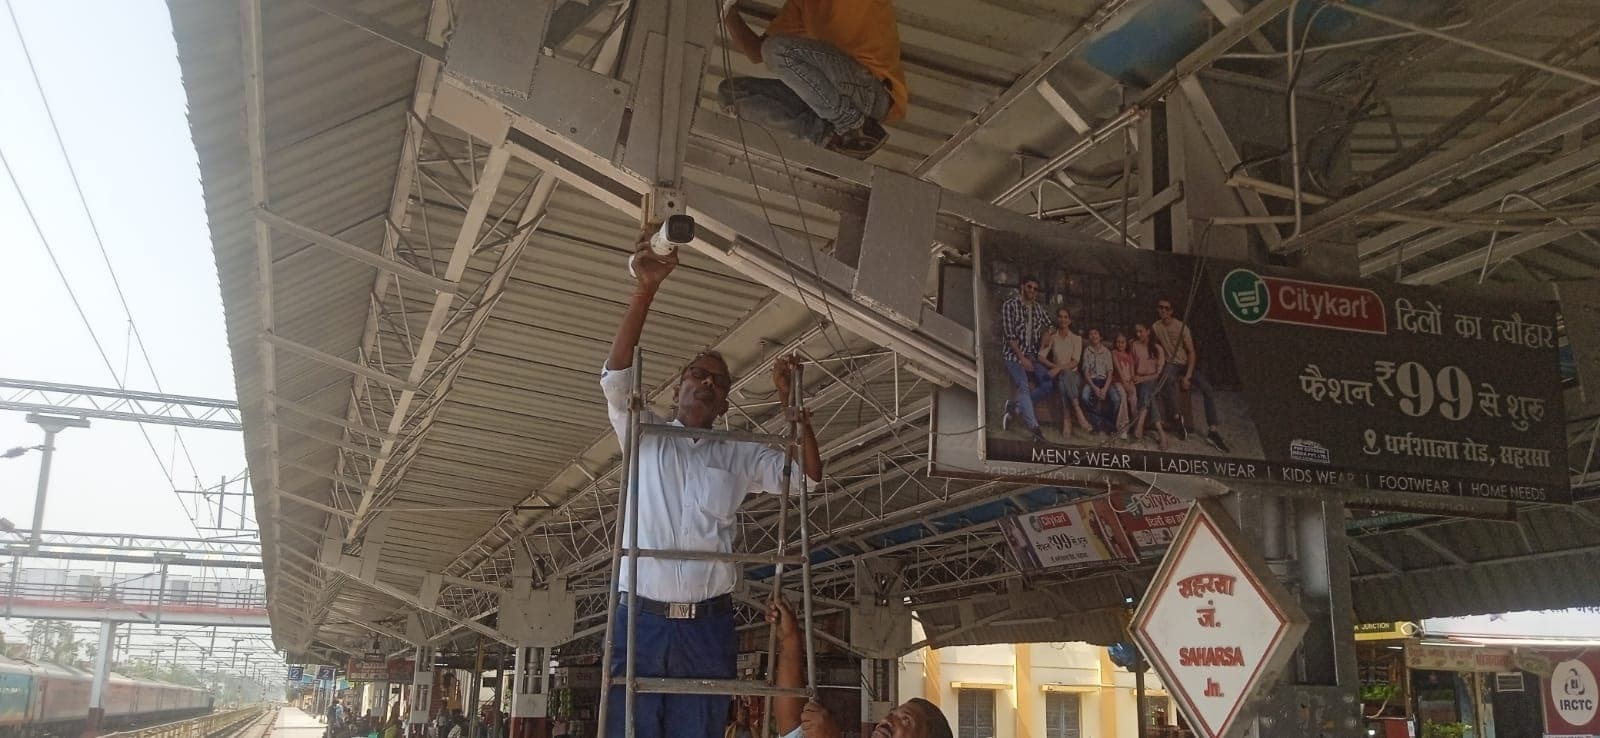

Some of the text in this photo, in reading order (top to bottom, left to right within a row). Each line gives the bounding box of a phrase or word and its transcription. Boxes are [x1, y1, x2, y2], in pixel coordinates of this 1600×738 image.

[1278, 286, 1369, 319] Citykart
[1394, 298, 1555, 349] दिलों का त्यौहार
[1299, 364, 1375, 406] फैशन
[1478, 383, 1502, 417] से
[1385, 432, 1551, 468] धर्मशाला रोड, सहरसा
[1031, 448, 1081, 465] MEN'S
[1086, 451, 1131, 469] WEAR
[1160, 457, 1209, 474] LADIES
[1213, 462, 1255, 478] WEAR
[1282, 467, 1313, 483] KIDS
[1315, 470, 1355, 486] WEAR
[1379, 476, 1450, 494] FOOTWEAR
[1472, 483, 1507, 498] HOME
[1510, 486, 1546, 501] NEEDS
[1176, 573, 1237, 599] सहरसा
[1197, 599, 1221, 629] जं.
[1179, 647, 1245, 667] SAHARSA
[1204, 678, 1224, 698] Jn.
[1560, 698, 1593, 711] IRCTC
